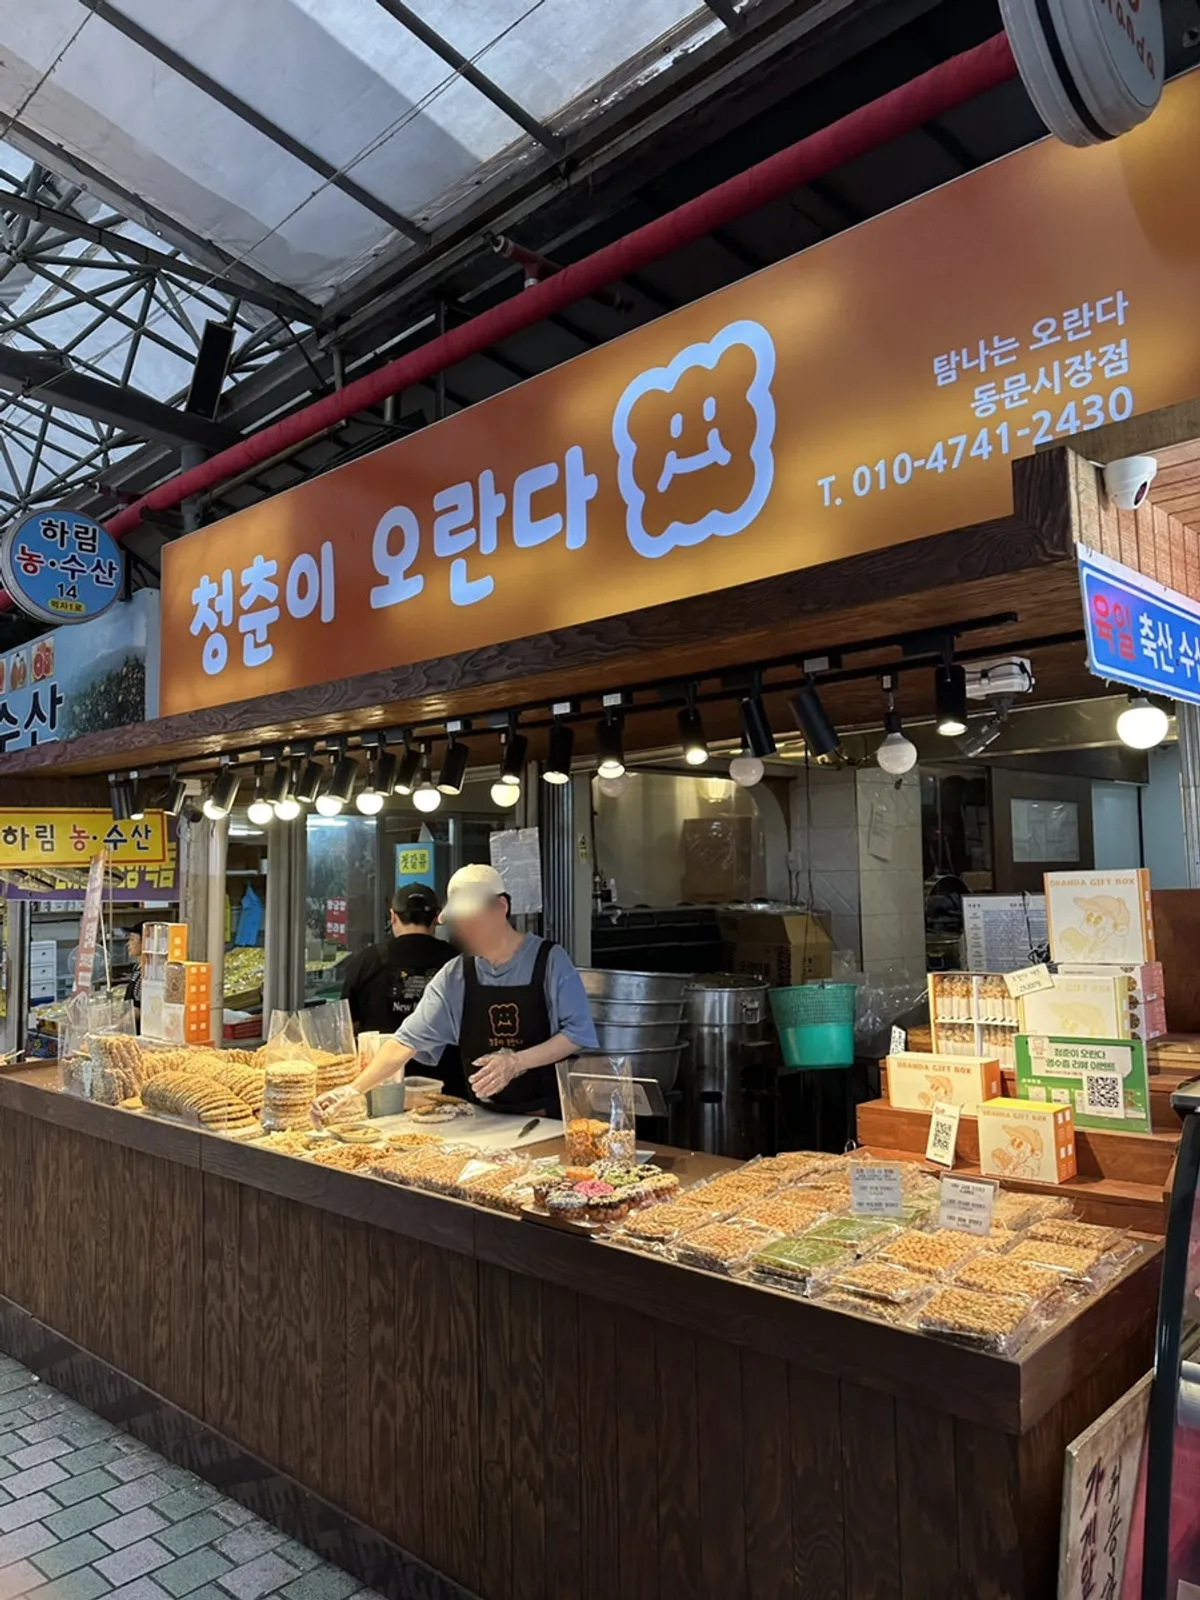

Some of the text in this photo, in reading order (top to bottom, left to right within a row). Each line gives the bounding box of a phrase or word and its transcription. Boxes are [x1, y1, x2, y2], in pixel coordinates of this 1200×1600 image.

[932, 289, 1129, 387] 탐나는 오란다
[970, 338, 1130, 418] 동문시장점
[817, 385, 1134, 507] T. 010-4741-2430
[15, 544, 119, 587] 농·수산
[40, 517, 99, 555] 하림
[189, 444, 599, 676] 청춘이 오란다
[56, 583, 79, 600] 14
[1139, 611, 1176, 675] 축산
[1178, 631, 1200, 682] 수
[1, 823, 152, 852] 하림 농·수산
